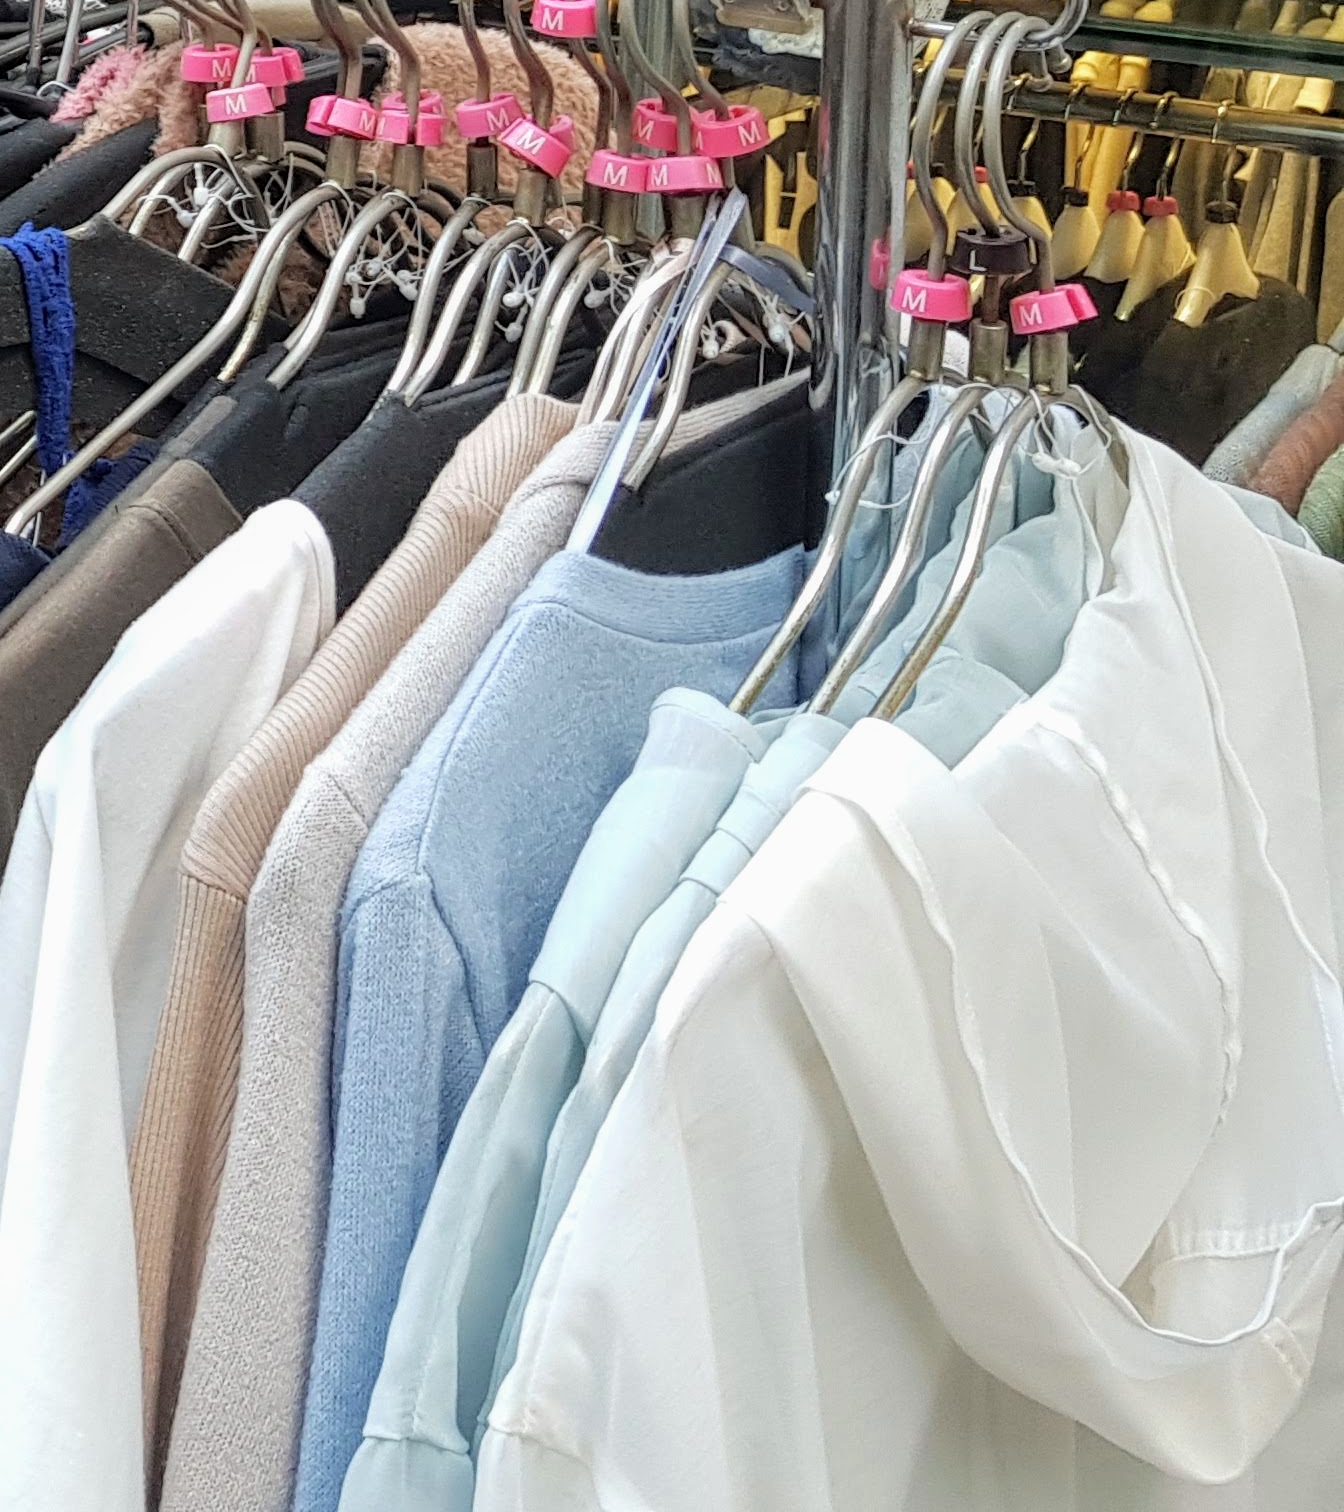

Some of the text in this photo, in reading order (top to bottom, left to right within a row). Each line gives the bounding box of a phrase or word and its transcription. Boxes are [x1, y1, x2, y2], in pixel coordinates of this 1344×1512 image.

[541, 7, 564, 31] M
[212, 57, 232, 79] M
[225, 93, 248, 116] M
[486, 107, 510, 132] M
[637, 115, 655, 142] M
[516, 126, 547, 156] M
[738, 120, 762, 148] M
[603, 162, 629, 187] M
[650, 164, 668, 187] M
[969, 249, 988, 272] L
[901, 286, 927, 313] M
[1018, 303, 1044, 328] M
